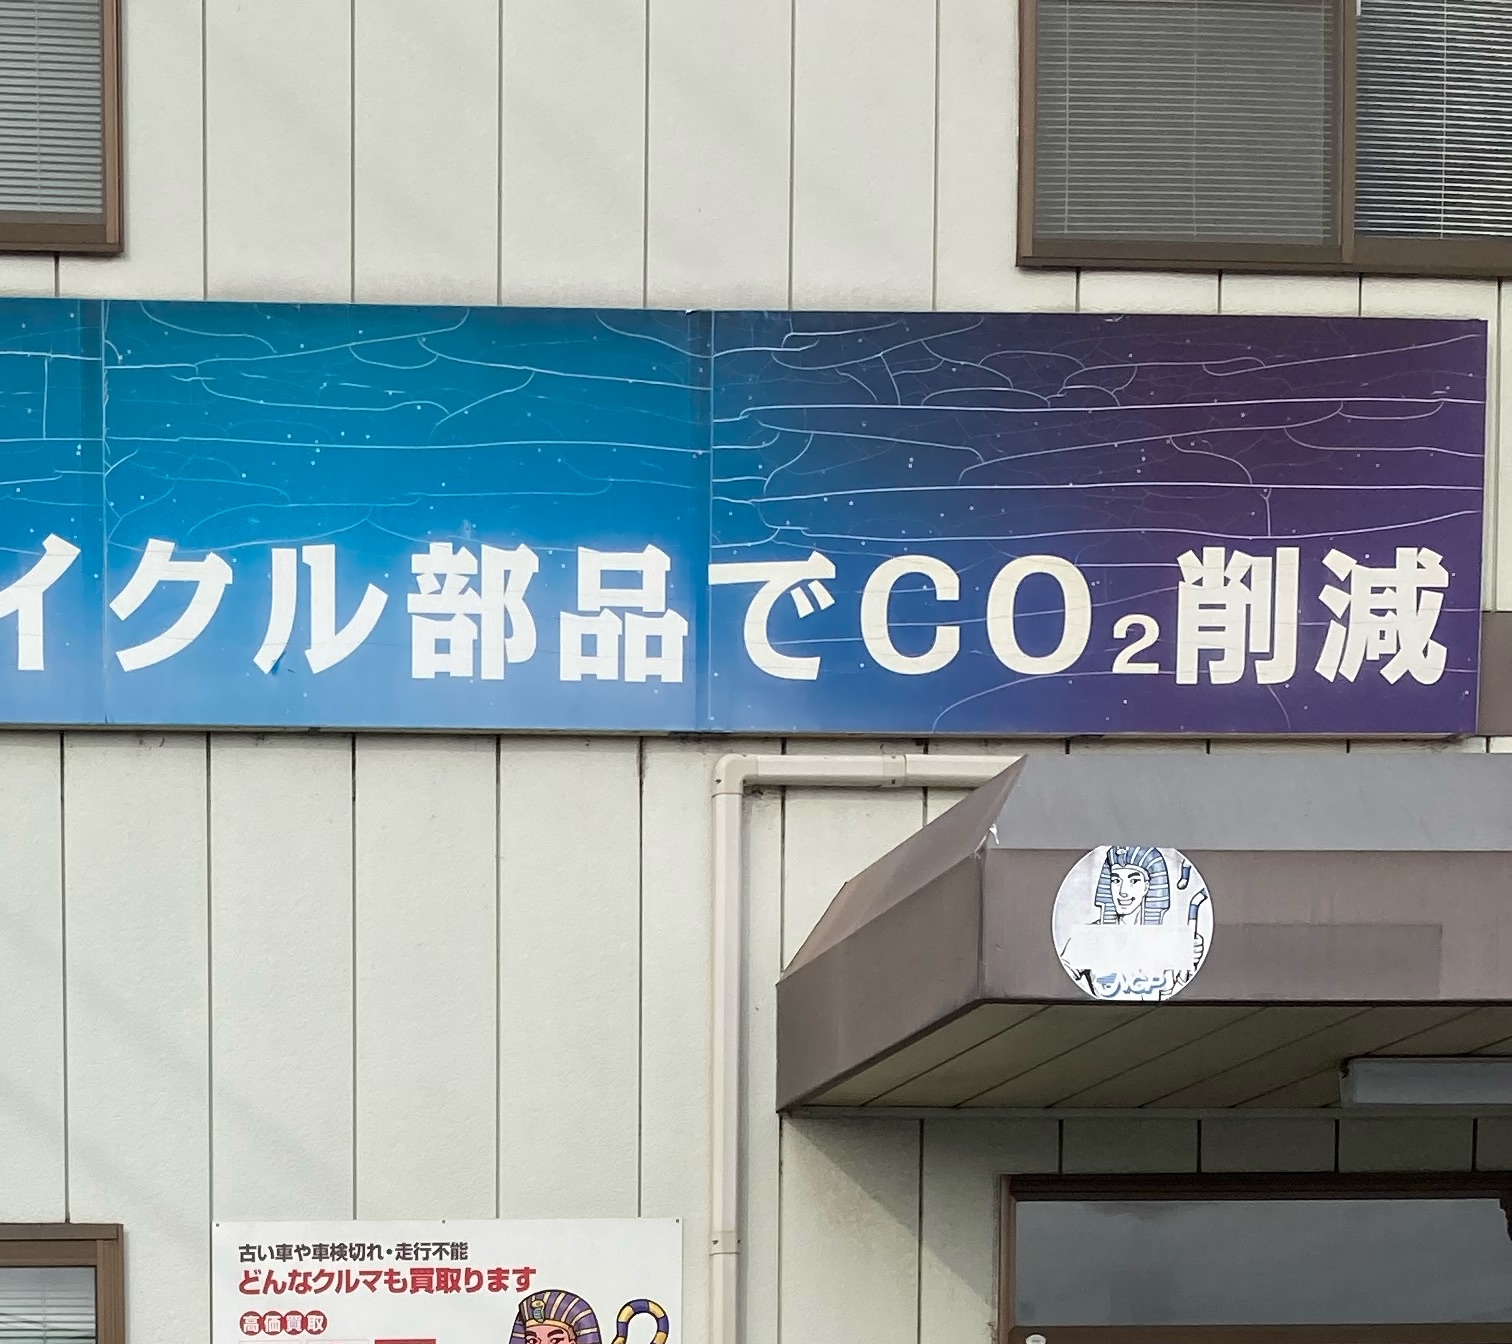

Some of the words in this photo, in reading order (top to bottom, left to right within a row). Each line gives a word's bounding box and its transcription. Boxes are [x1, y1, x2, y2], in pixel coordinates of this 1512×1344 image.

[238, 1242, 468, 1262] 古い車や車検切れ・走行不能
[238, 1267, 536, 1294] どんなクルマも買取ります
[241, 1312, 326, 1334] 高価買取
